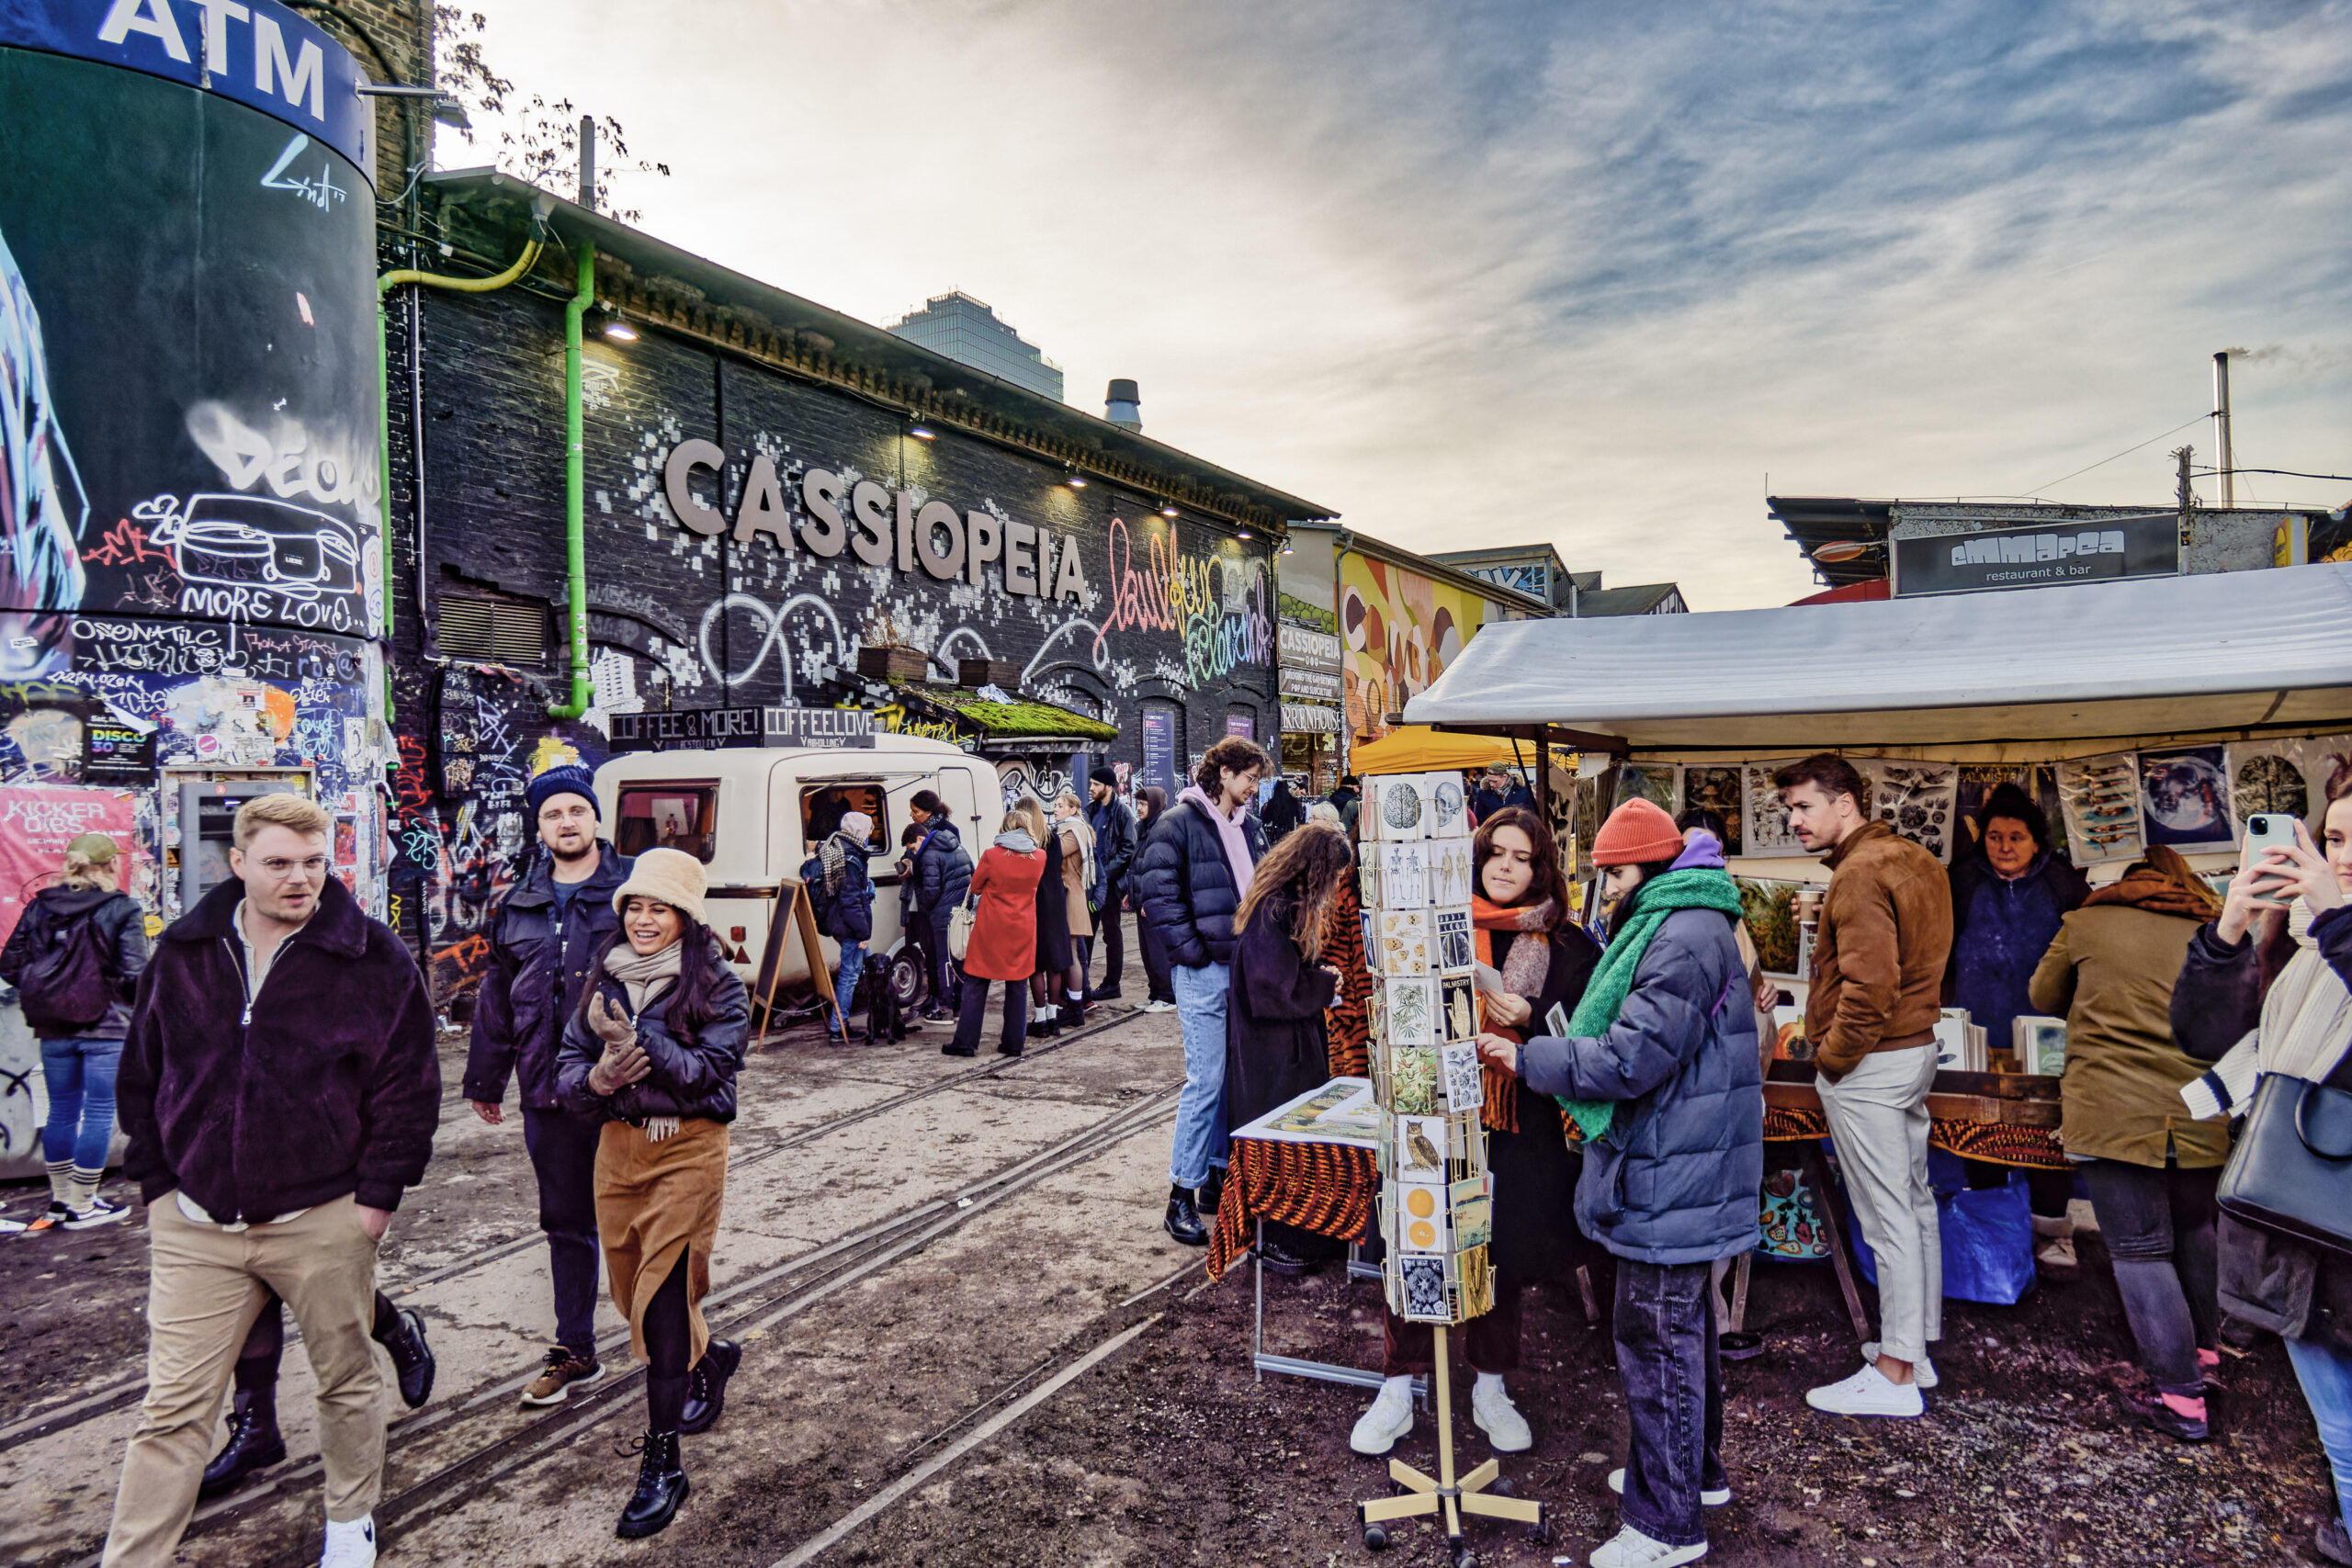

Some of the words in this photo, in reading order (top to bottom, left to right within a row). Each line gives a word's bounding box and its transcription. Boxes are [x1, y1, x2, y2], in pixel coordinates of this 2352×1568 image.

[98, 0, 324, 122] ATM
[664, 438, 1089, 605] CASSIOPEIA
[1985, 567, 2052, 581] restaurant
[2055, 566, 2065, 576] &
[2069, 564, 2092, 576] bar
[182, 586, 273, 626] MORE
[1280, 628, 1340, 660] CASSIOPEIA
[1285, 670, 1305, 682] BRIDGING
[1305, 672, 1313, 683] THE
[1320, 675, 1338, 687] BETWEEN
[1291, 682, 1300, 693] POP
[1300, 684, 1310, 694] AND
[1309, 685, 1333, 698] SUBCULTURE
[611, 712, 684, 740] COFFEE
[685, 715, 697, 737] &
[701, 708, 759, 736] MORE!
[764, 707, 875, 737] COFFEELOVE
[91, 741, 114, 753] 30
[92, 729, 147, 743] DISCO
[4, 800, 106, 822] KICKER
[1442, 978, 1470, 989] PALMISTRY
